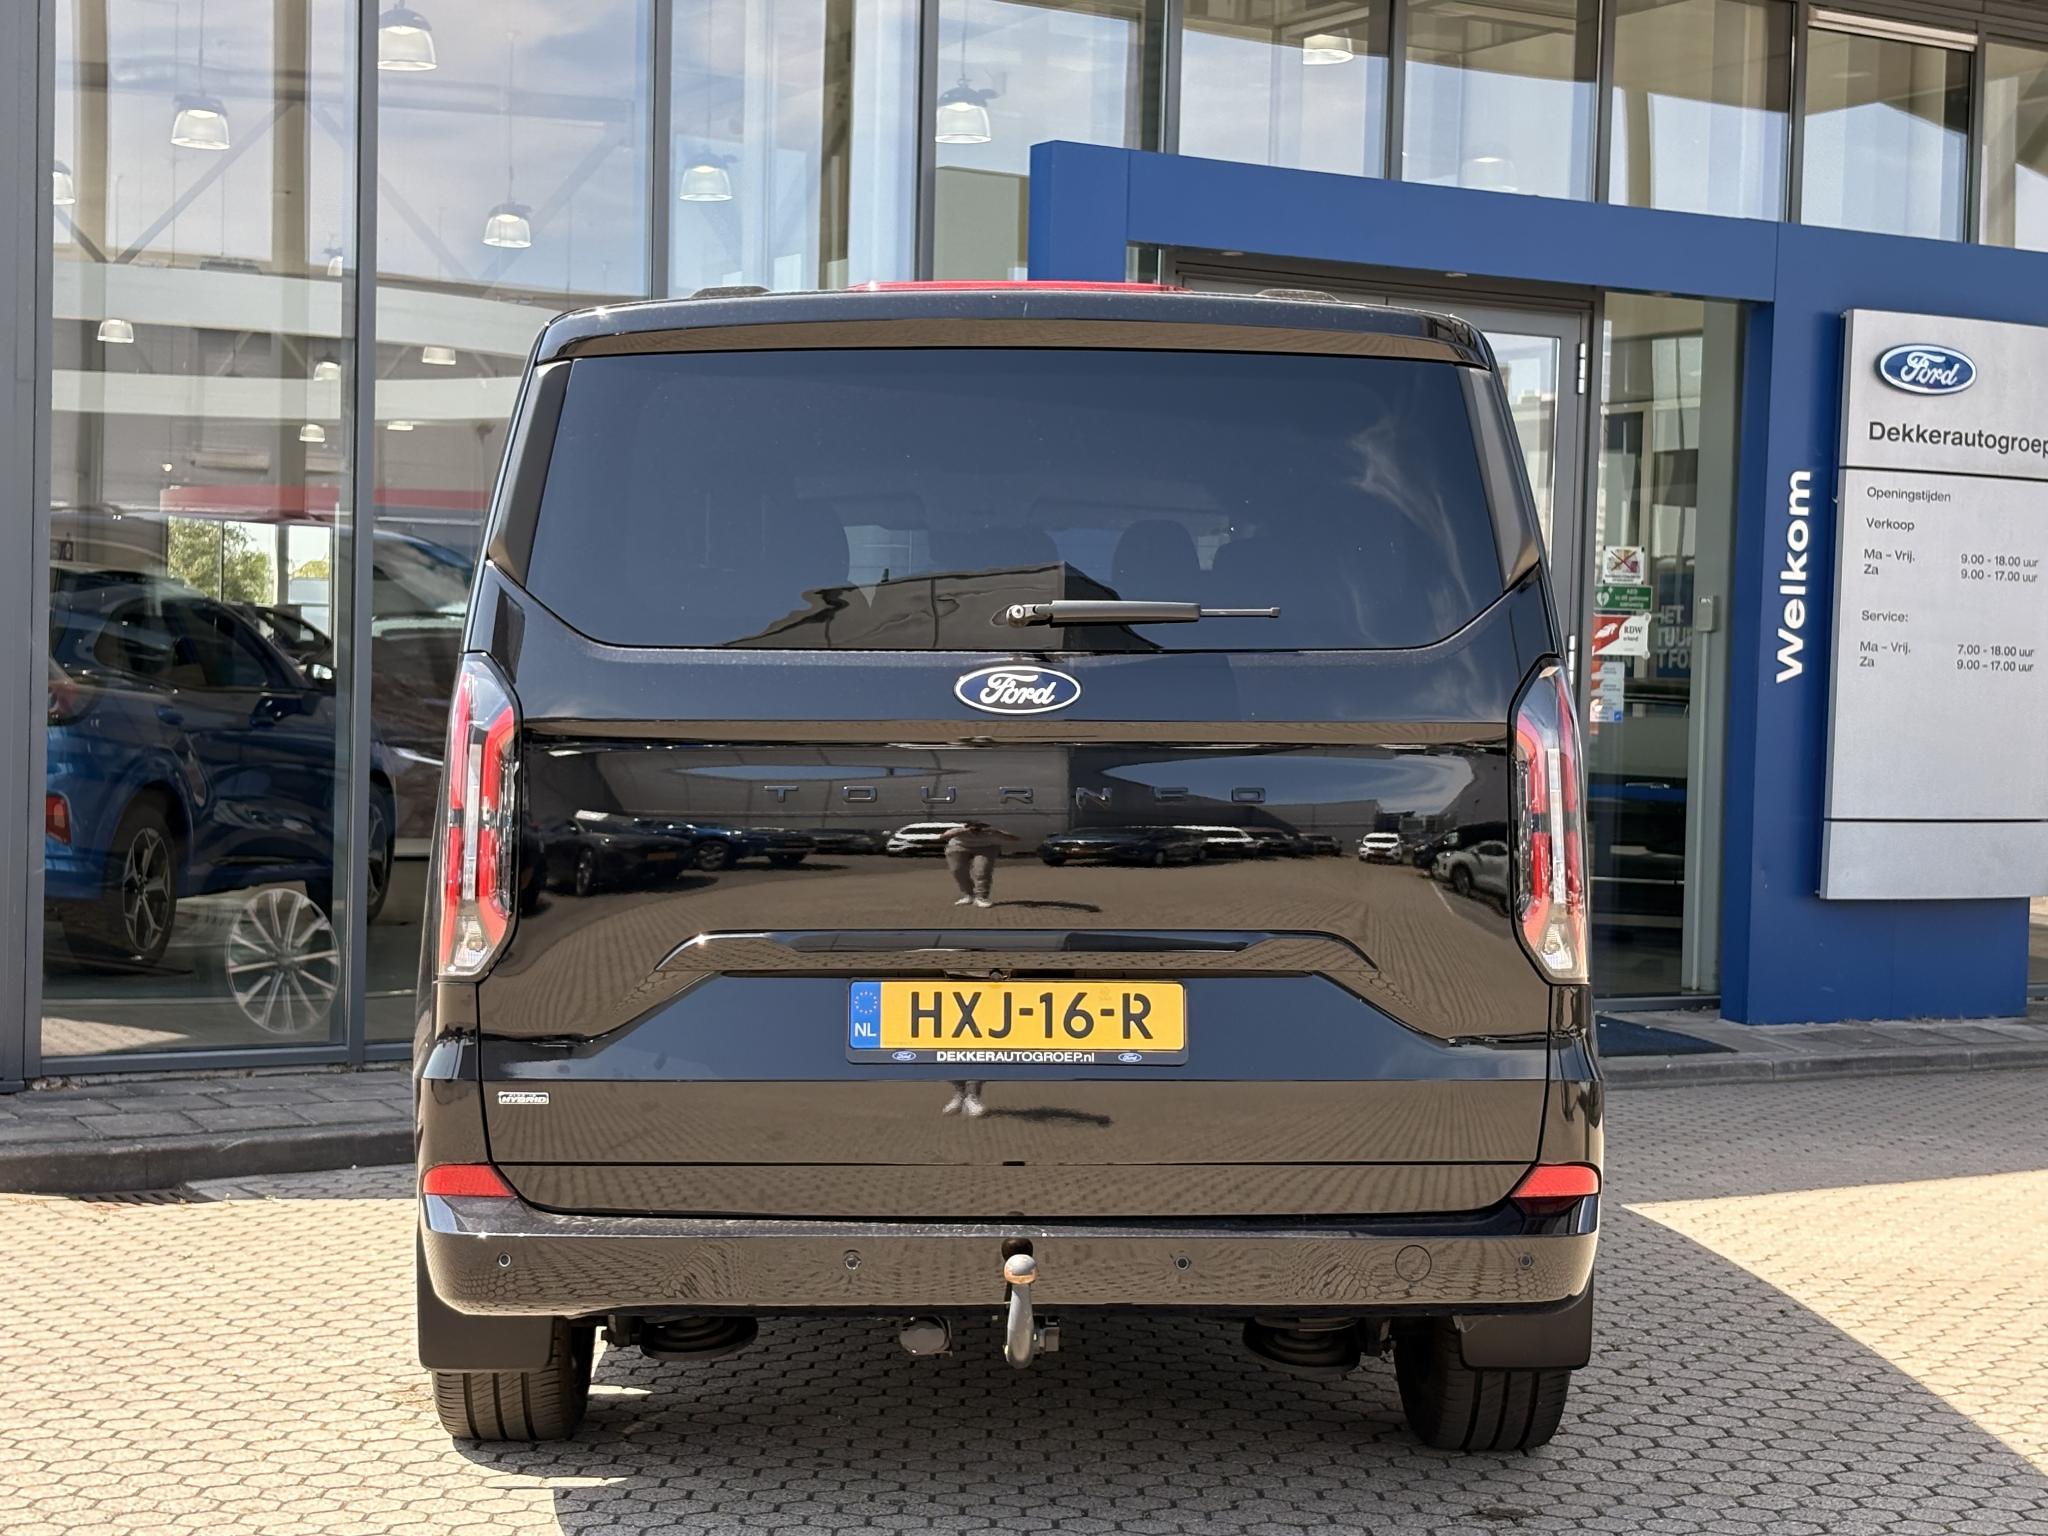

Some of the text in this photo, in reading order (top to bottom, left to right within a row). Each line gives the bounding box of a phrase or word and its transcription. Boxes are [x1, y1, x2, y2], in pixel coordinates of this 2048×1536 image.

[1900, 351, 1960, 386] Ford
[1866, 486, 1951, 503] Openingstijden
[1866, 517, 1915, 533] Verkoop
[1863, 548, 1883, 560] Ma
[1960, 553, 1985, 565] 9.00
[1994, 555, 2021, 567] 18.00
[2023, 557, 2039, 568] uur
[1775, 470, 1811, 684] Welkom
[1863, 563, 1879, 575] Za
[1960, 568, 1985, 580] 9.00
[1994, 570, 2021, 582] 17.00
[2022, 572, 2038, 583] uur
[1861, 609, 1909, 622] Service:
[1623, 625, 1643, 634] RDW
[1859, 641, 1879, 652] Ma
[1957, 643, 1981, 655] 7.00
[1990, 645, 2017, 657] 18.00
[2018, 648, 2035, 658] uur
[1859, 656, 1875, 667] Za
[1956, 659, 1980, 671] 9.00
[1990, 661, 2016, 672] 17.00
[2018, 663, 2034, 673] uur
[979, 672, 1057, 705] Ford
[763, 784, 1267, 807] TOURNEO
[910, 991, 1154, 1040] HXJ-16-R
[854, 1022, 877, 1038] NL
[936, 1051, 1095, 1063] DEKKERAUTOGROEP.nl
